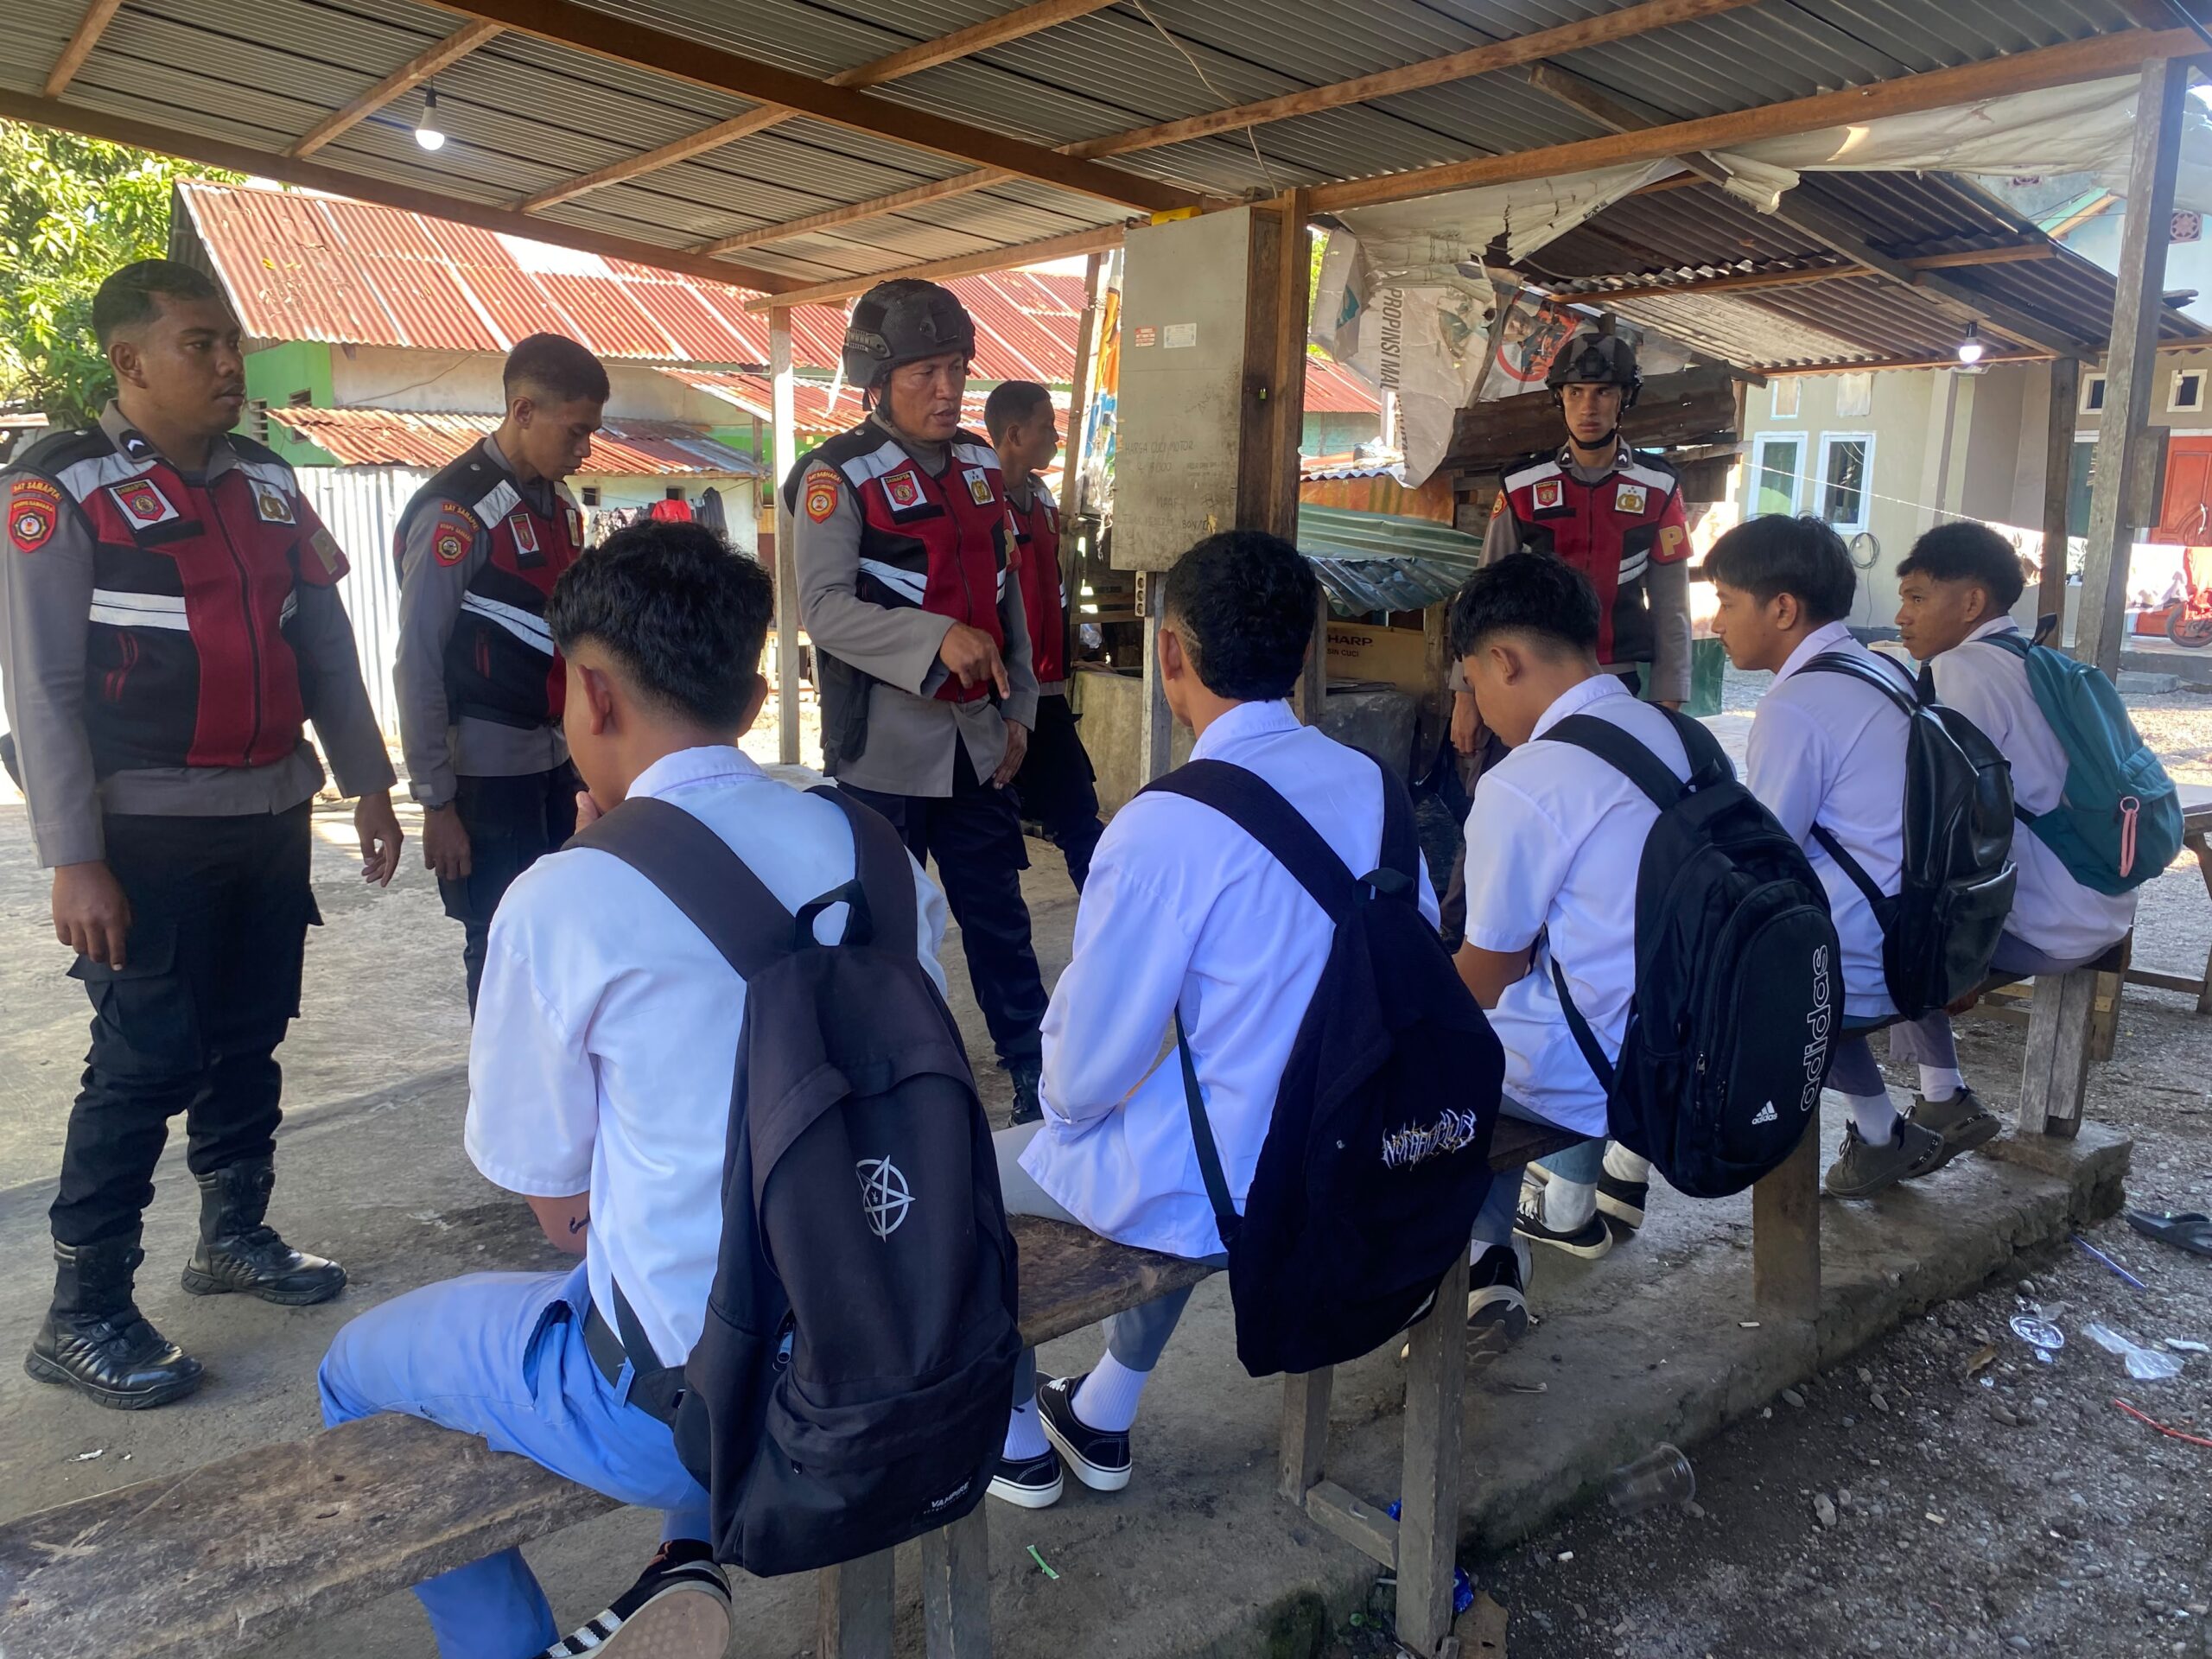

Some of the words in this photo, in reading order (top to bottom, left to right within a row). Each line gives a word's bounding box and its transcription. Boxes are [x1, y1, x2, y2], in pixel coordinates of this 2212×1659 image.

[1381, 288, 1403, 358] PROPINSI
[27, 480, 61, 499] SAMAPTA
[1327, 634, 1373, 646] HARP
[1801, 944, 1831, 1112] adidas
[1751, 1112, 1778, 1125] adidas
